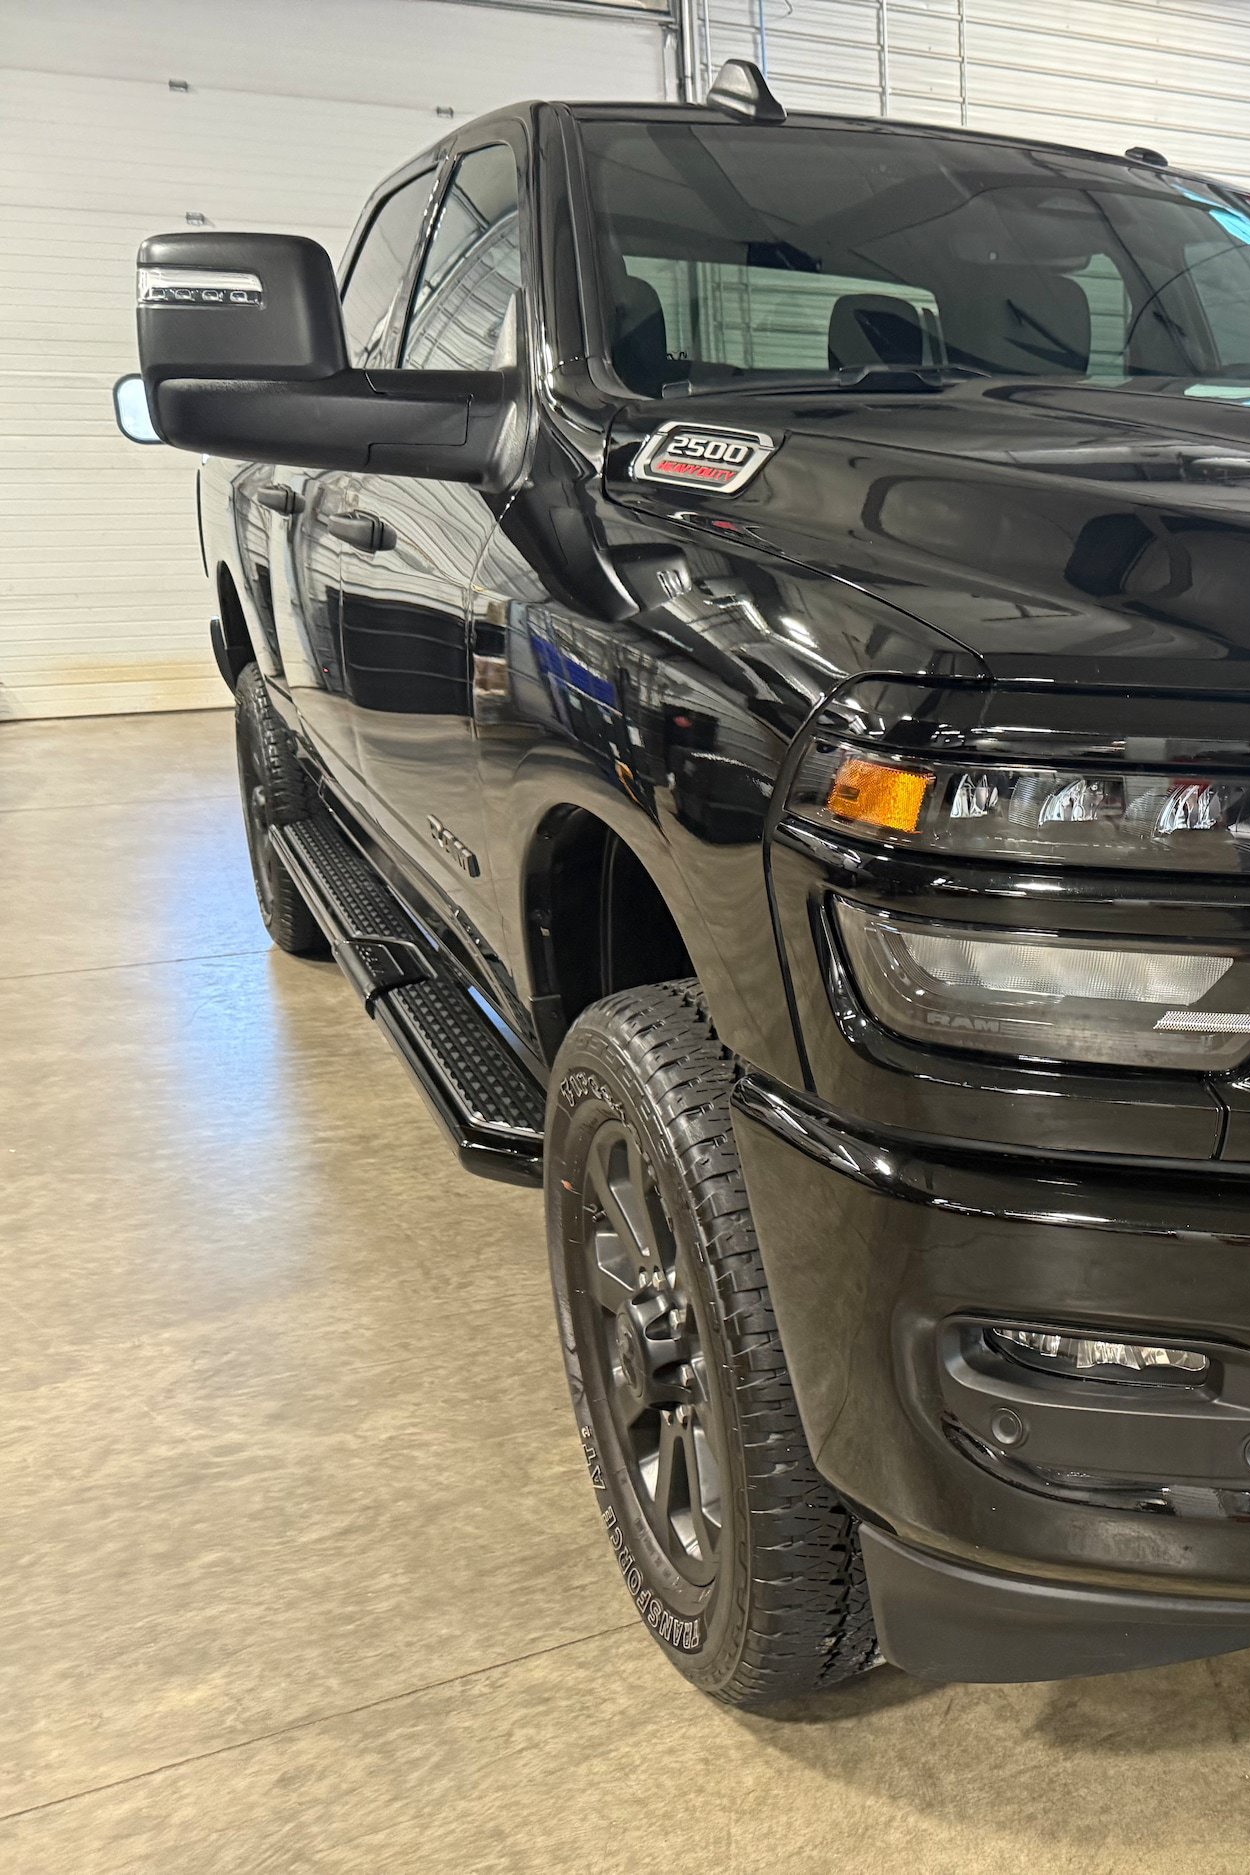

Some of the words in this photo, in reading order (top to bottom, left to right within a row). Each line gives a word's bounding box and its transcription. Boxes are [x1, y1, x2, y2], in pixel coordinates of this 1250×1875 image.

[667, 436, 749, 464] 2500
[656, 461, 699, 476] HEAVY
[696, 467, 737, 481] DUTY
[927, 1012, 1000, 1033] RAM
[602, 1505, 701, 1650] TRANSFORCE
